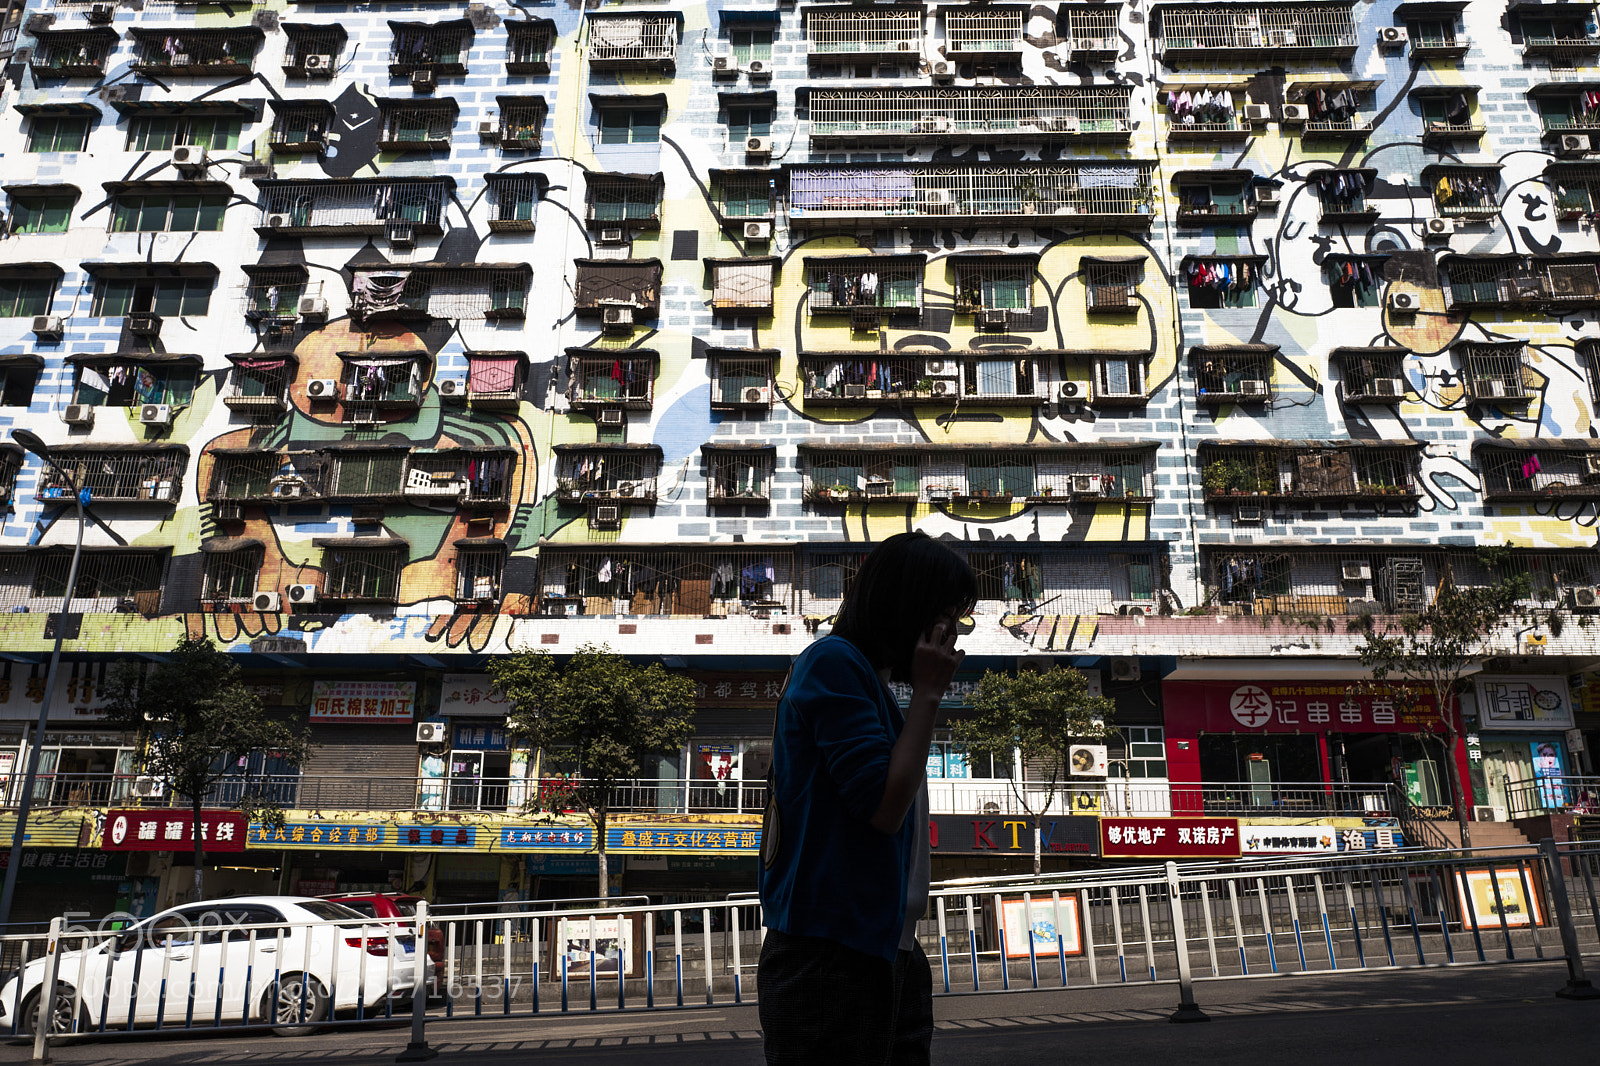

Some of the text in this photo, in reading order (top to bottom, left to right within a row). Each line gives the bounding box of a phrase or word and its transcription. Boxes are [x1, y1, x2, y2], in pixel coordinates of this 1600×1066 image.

[314, 697, 411, 716] 何氏棉絮加工
[1466, 732, 1482, 763] 美甲
[971, 820, 1057, 849] KTV
[1108, 825, 1235, 846] 够优地产 双诺房产
[1342, 828, 1398, 852] 渔具
[21, 852, 109, 868] 健康生活馆
